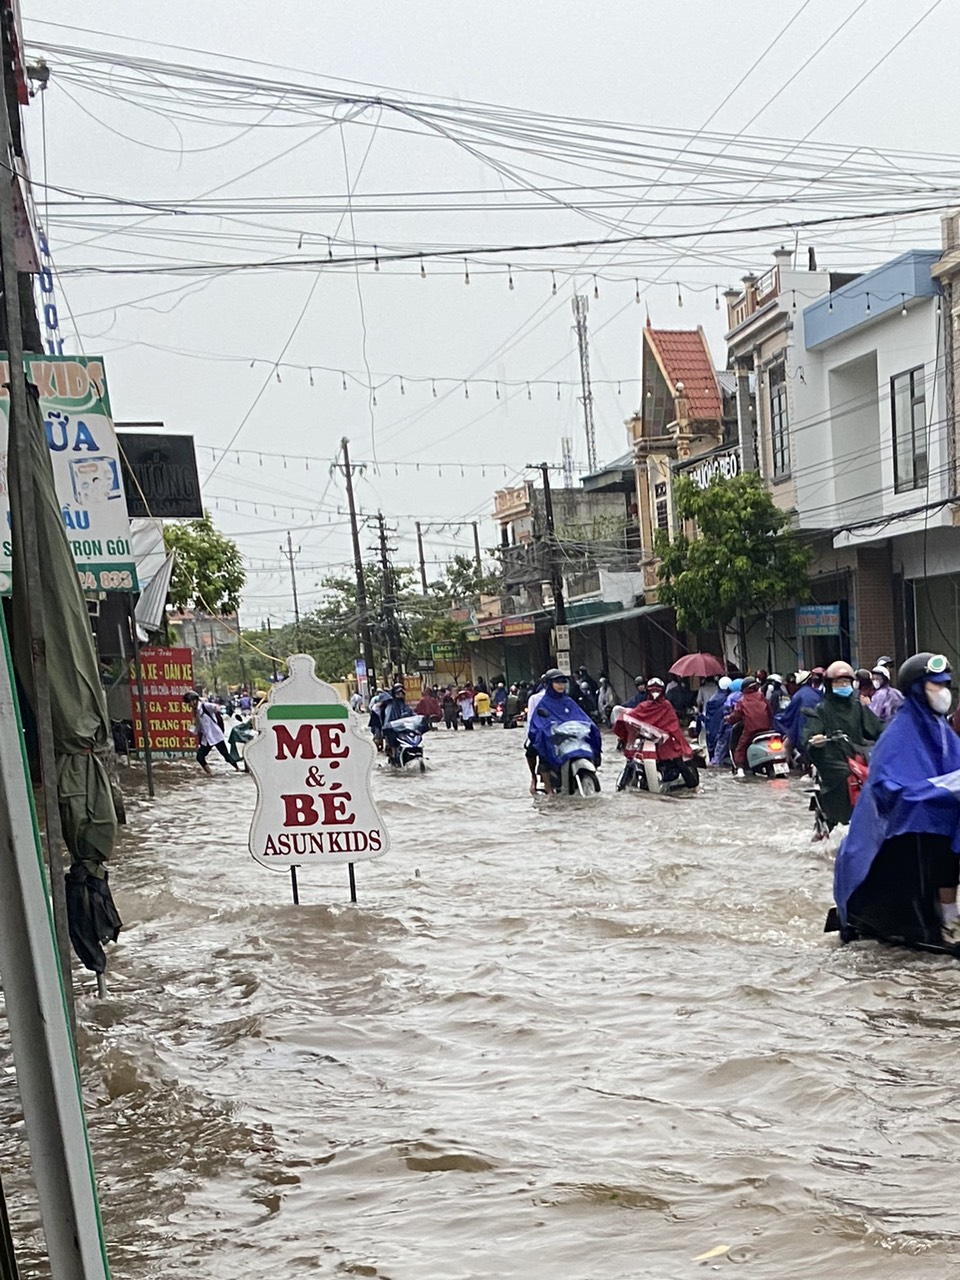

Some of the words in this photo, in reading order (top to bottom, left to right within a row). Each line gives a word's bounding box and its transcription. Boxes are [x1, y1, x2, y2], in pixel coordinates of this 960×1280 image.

[30, 361, 104, 397] KIDS
[45, 411, 100, 451] ỮA
[106, 536, 131, 556] GÓI
[147, 664, 158, 680] XE
[182, 663, 192, 681] XE
[149, 701, 161, 713] GA
[168, 702, 179, 713] XE
[149, 720, 179, 731] TRANG
[155, 735, 180, 748] CHƠI
[271, 723, 350, 770] MẸ
[305, 766, 327, 788] &
[280, 782, 356, 827] BÉ
[263, 832, 324, 857] ASUN
[326, 829, 382, 853] KIDS
